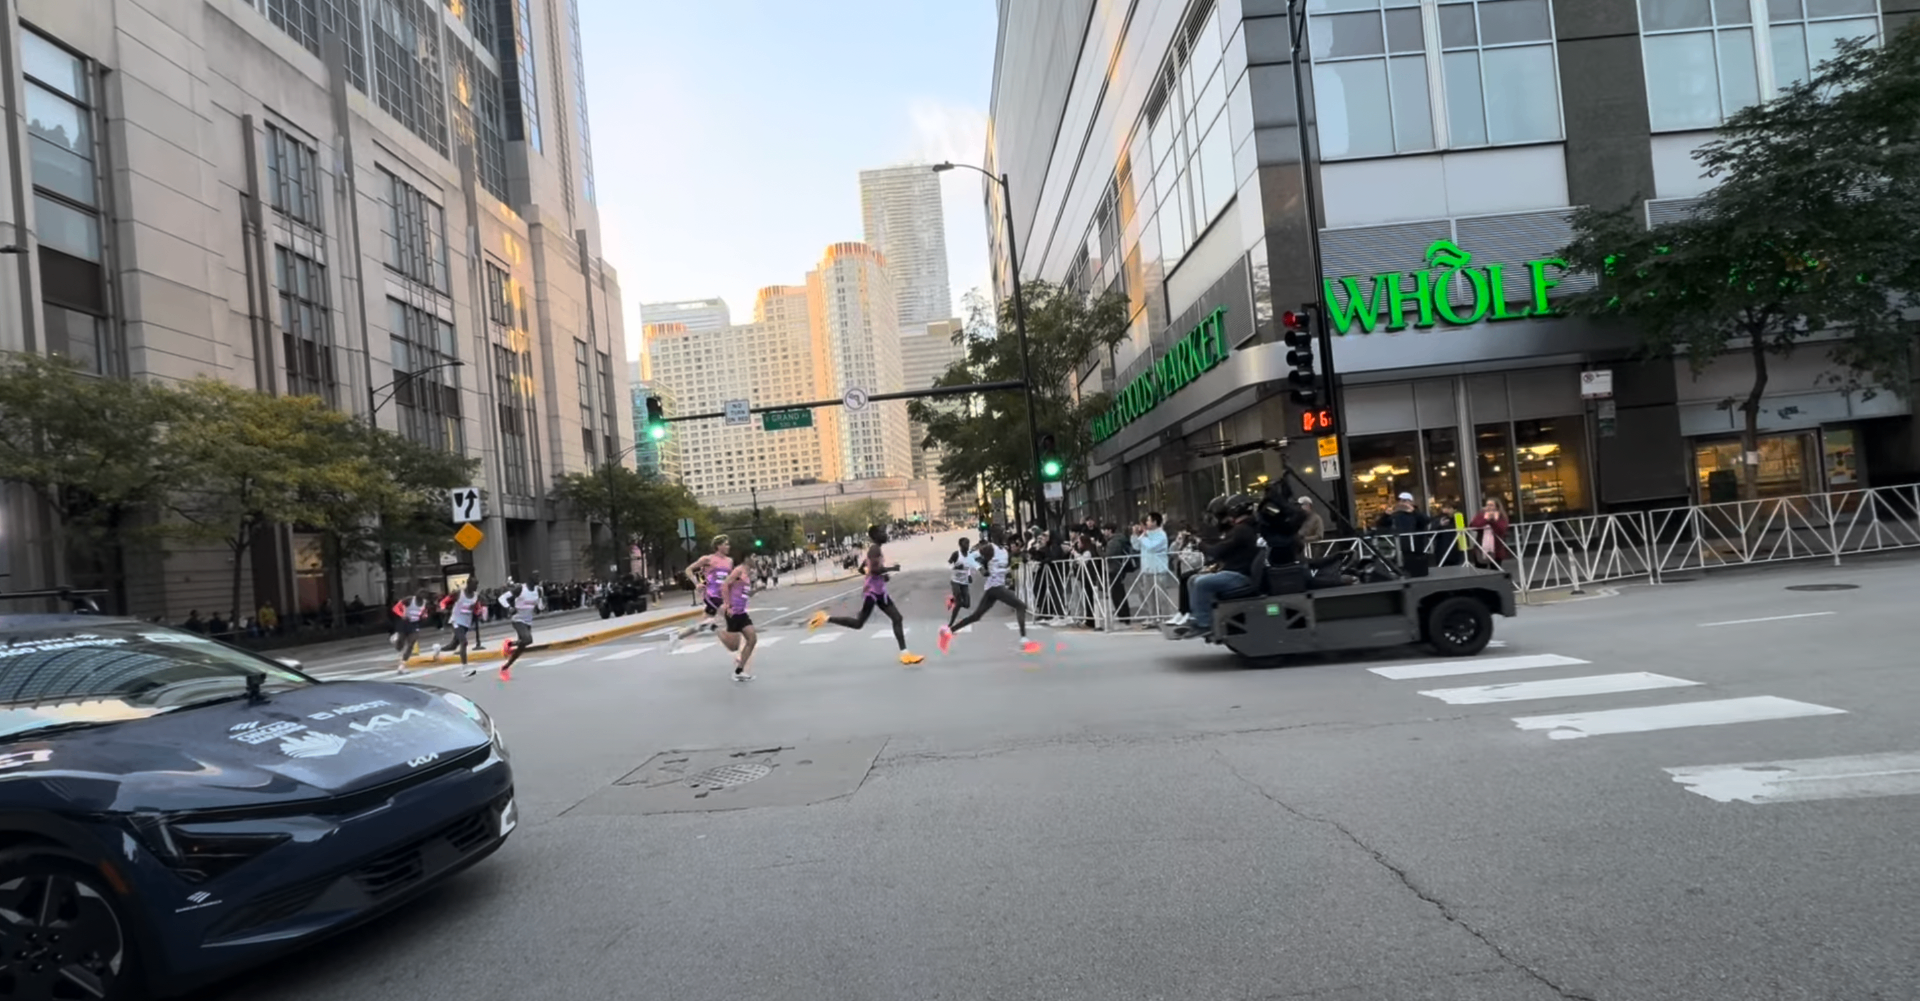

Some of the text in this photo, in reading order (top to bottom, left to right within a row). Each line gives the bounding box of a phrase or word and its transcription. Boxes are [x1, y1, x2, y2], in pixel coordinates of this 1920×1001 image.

[1323, 239, 1568, 334] WHOLE
[1115, 365, 1159, 427] FOODS
[1155, 304, 1230, 401] MARKET
[771, 412, 800, 422] GRAND
